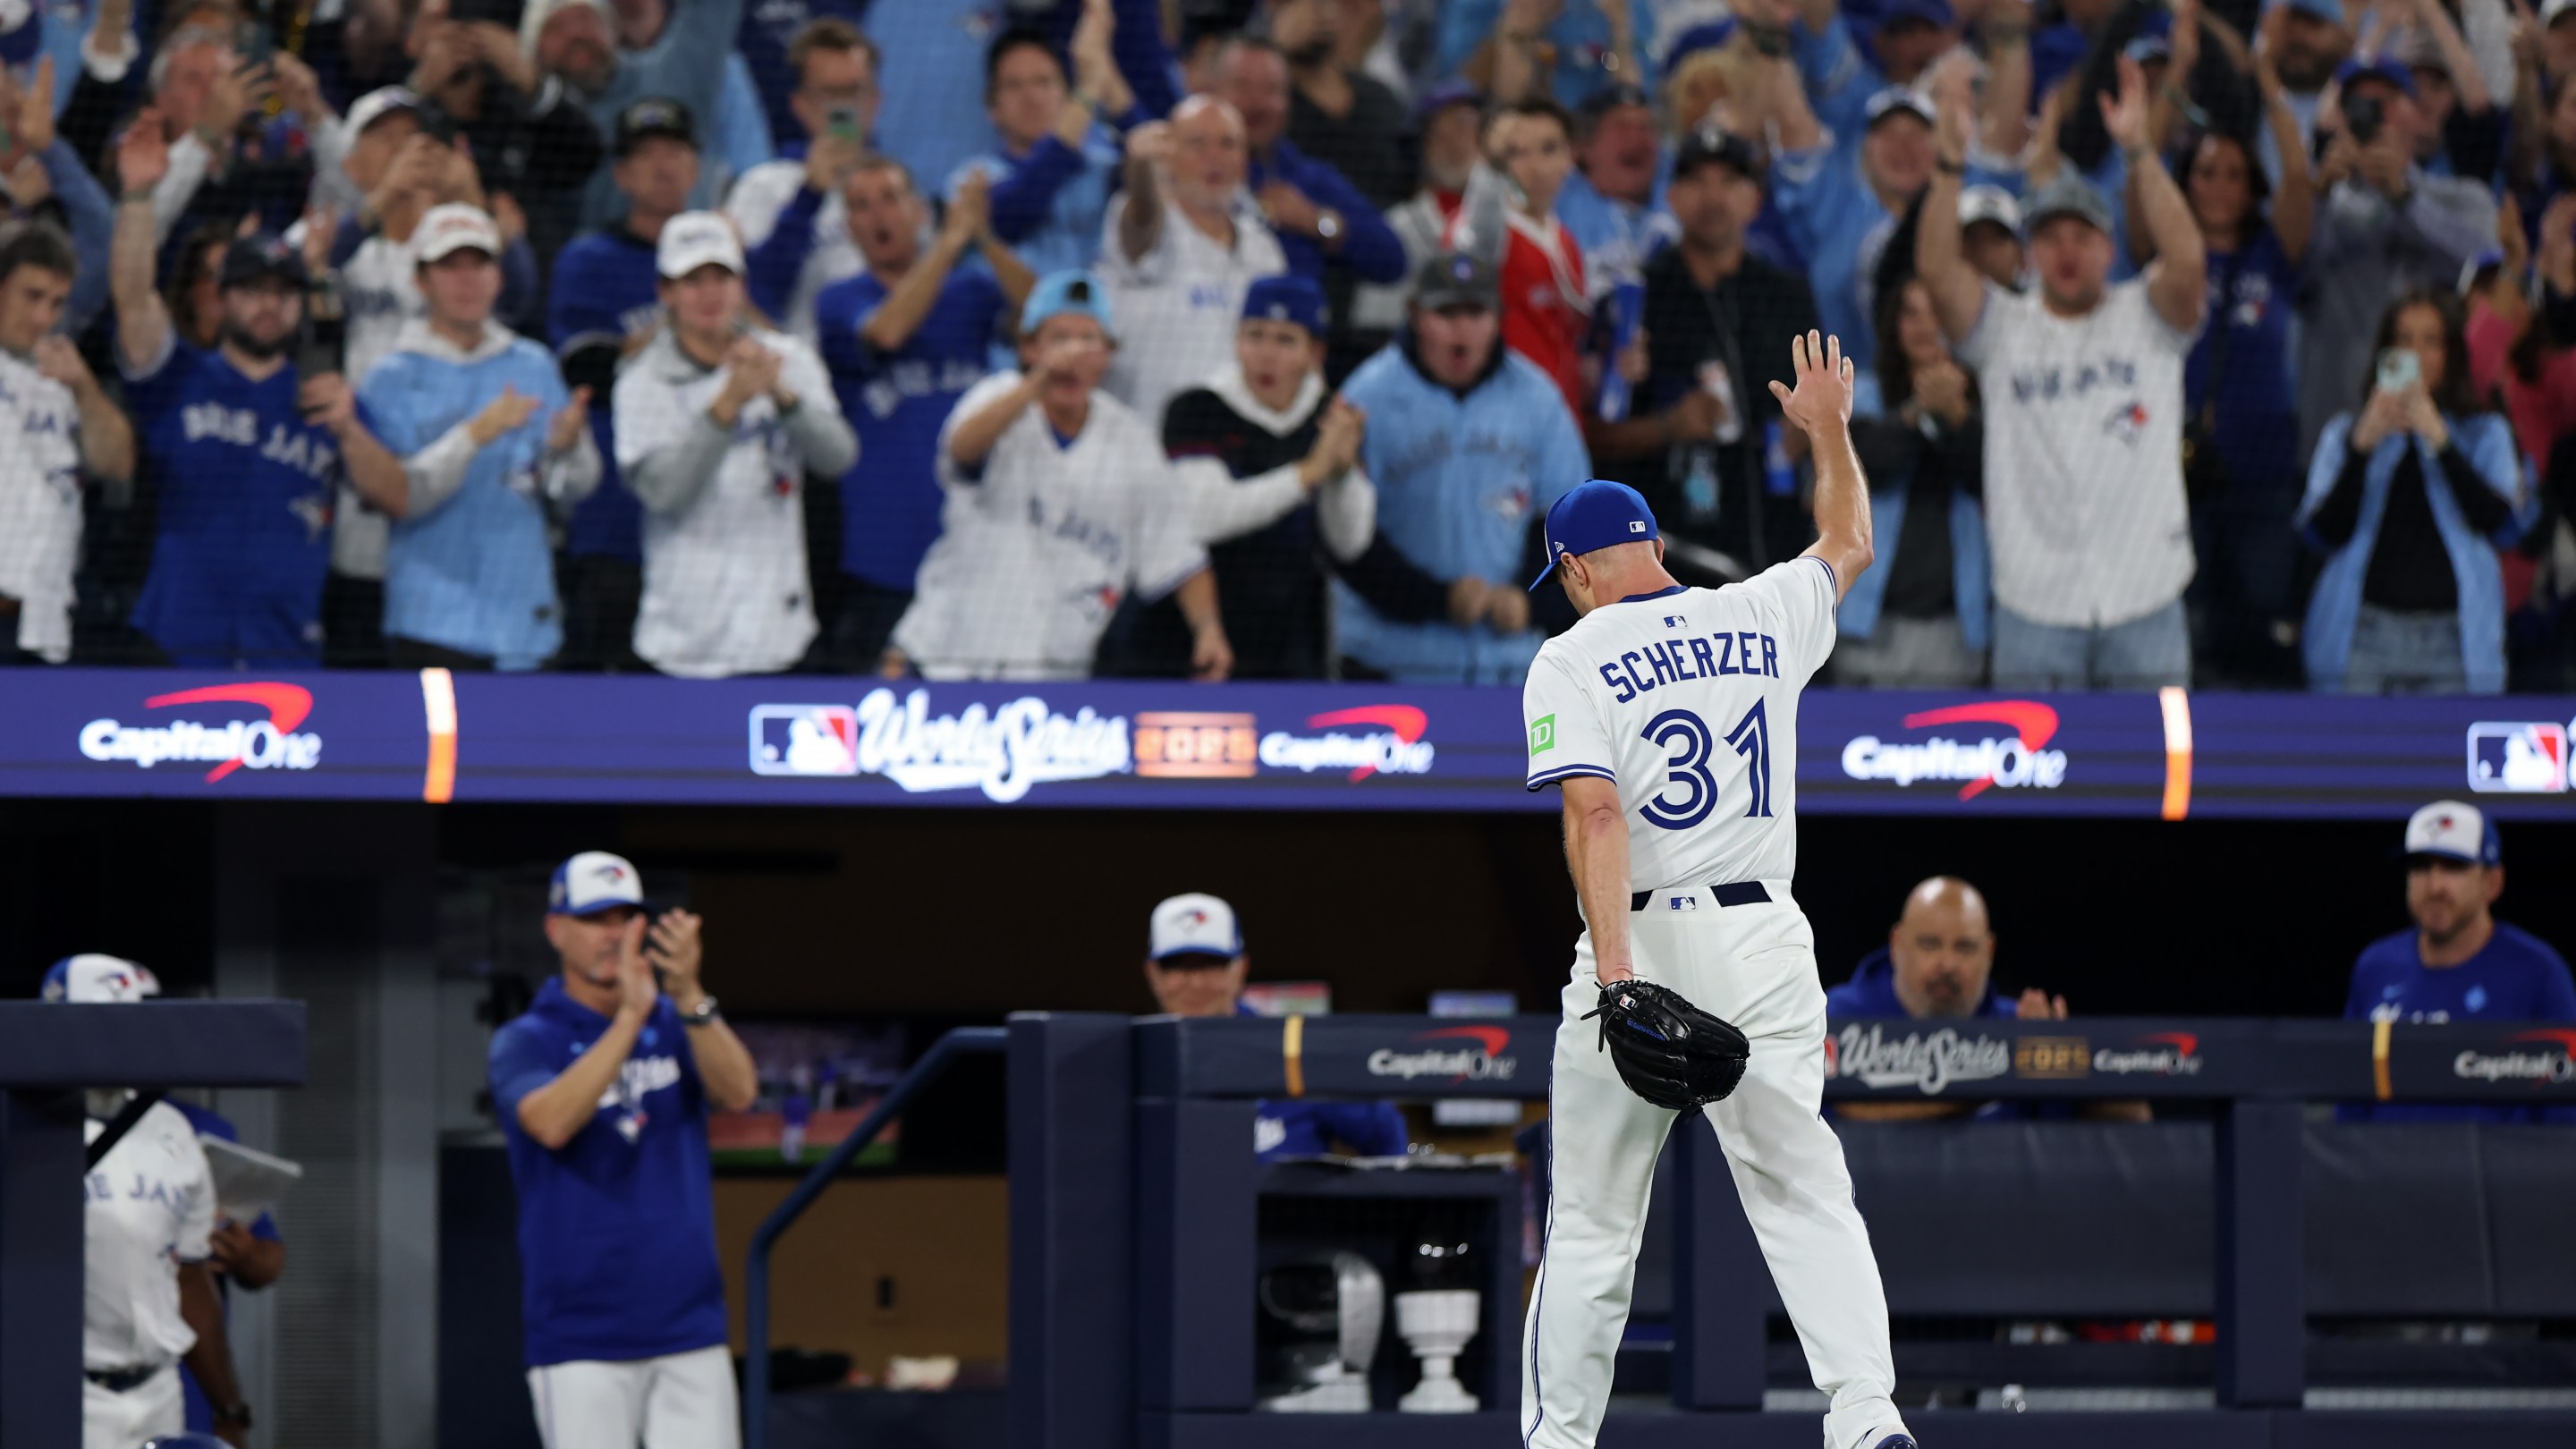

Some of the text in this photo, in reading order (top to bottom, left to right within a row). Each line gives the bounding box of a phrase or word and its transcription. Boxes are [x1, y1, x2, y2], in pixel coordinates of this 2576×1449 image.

[1599, 631, 1779, 704] SCHERZER
[1530, 722, 1551, 750] TD
[1639, 695, 1774, 830] 31
